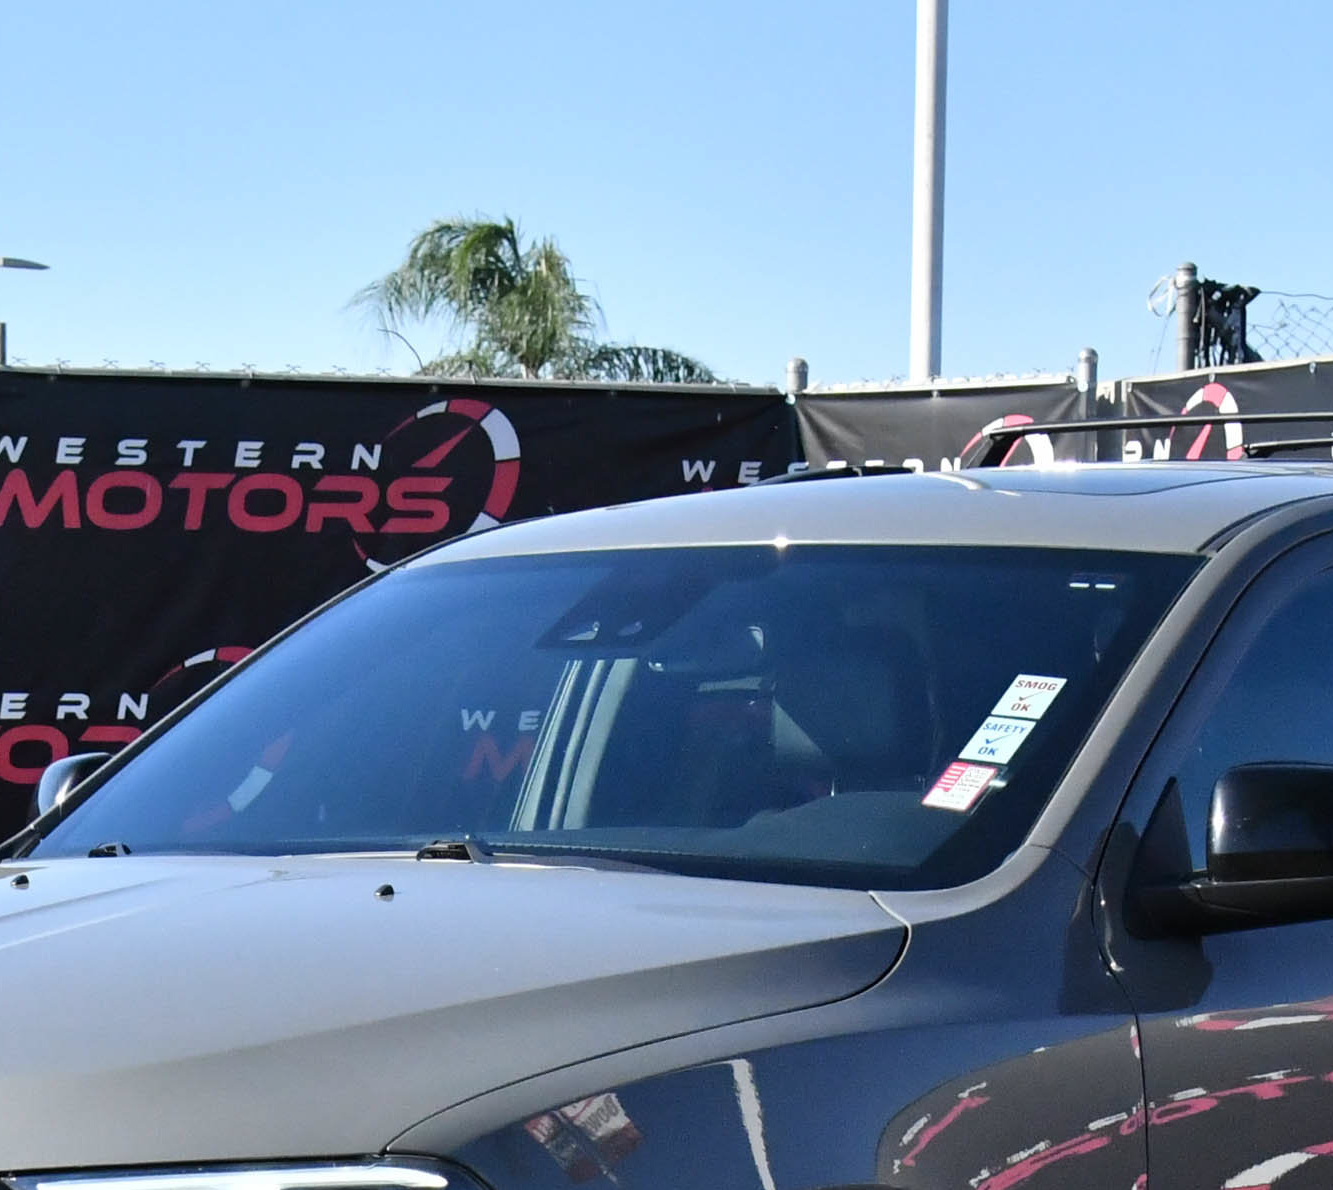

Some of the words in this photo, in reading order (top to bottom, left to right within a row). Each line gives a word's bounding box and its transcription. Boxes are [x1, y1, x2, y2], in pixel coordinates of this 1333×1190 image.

[1015, 680, 1058, 691] SMOG
[1011, 703, 1031, 712] OK
[983, 722, 1026, 734] SAFETY
[978, 746, 999, 756] OK
